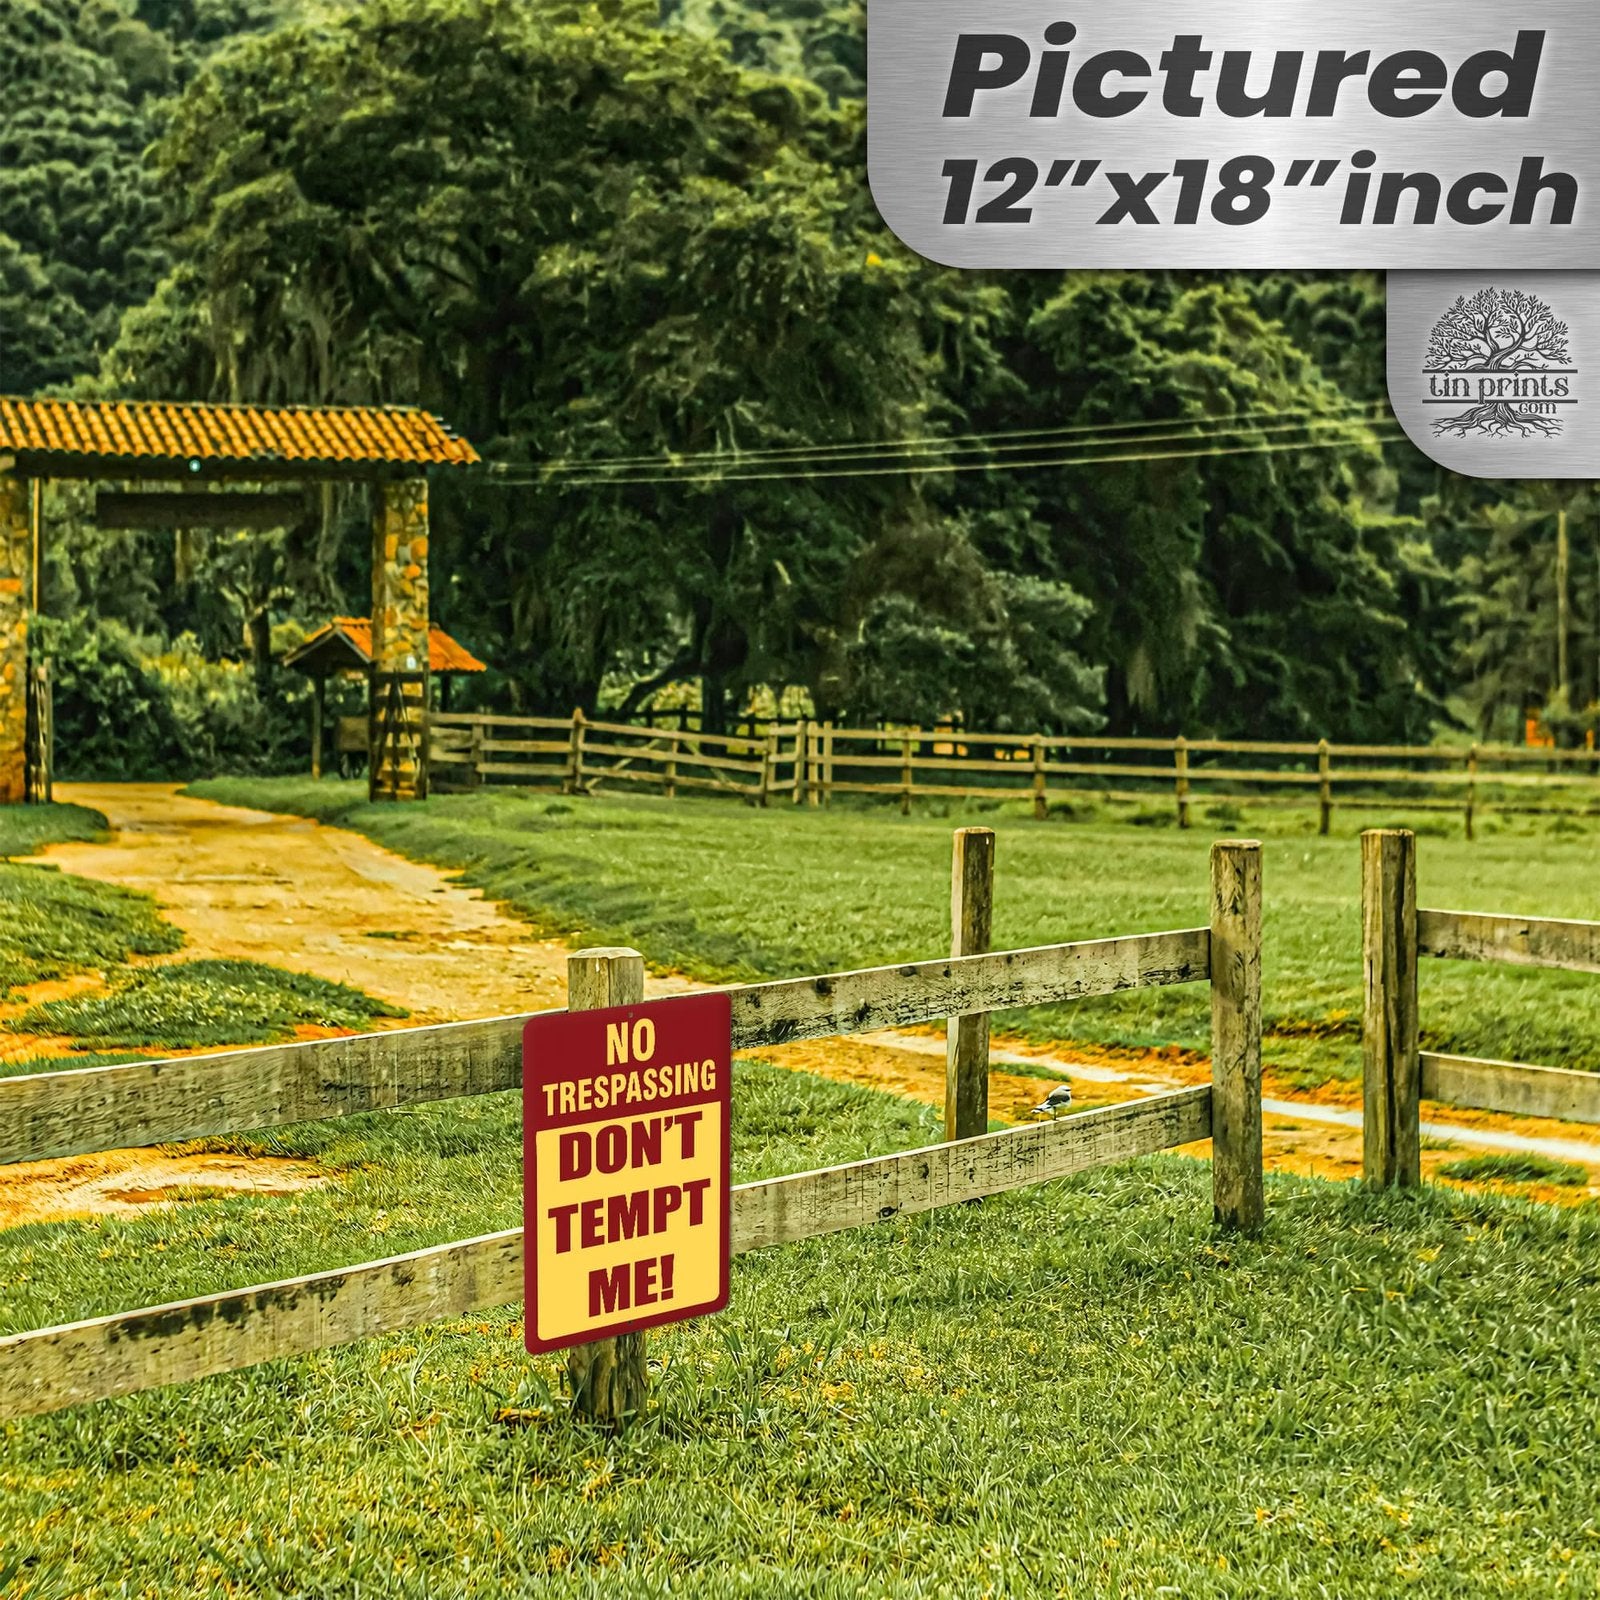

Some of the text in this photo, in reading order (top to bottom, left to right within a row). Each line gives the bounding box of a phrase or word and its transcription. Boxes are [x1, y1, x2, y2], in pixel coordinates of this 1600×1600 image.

[606, 1018, 656, 1066] NO
[543, 1059, 717, 1117] TRESPASSING
[559, 1111, 703, 1182] DON'T
[548, 1178, 711, 1254] TEMPT
[588, 1254, 675, 1318] ME!
